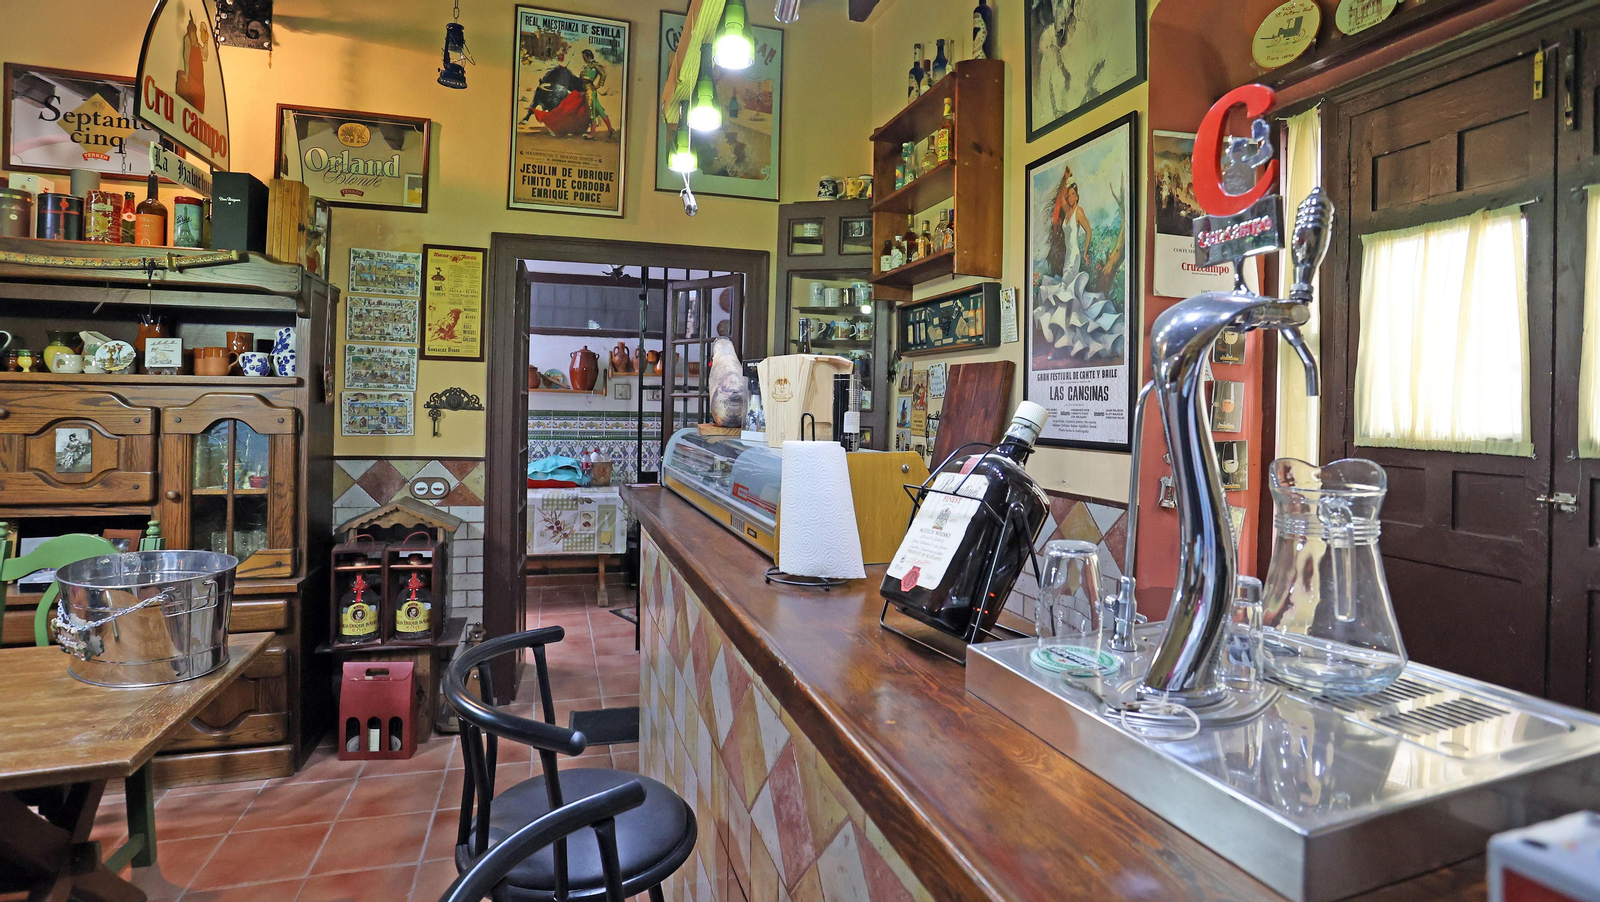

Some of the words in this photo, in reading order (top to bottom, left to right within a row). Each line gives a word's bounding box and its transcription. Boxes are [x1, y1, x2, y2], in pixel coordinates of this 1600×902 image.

[525, 16, 538, 26] REAL
[542, 18, 578, 32] MAESTRANZA
[582, 24, 588, 34] DE
[591, 26, 620, 38] SEVILLA
[143, 75, 174, 124] Cru
[182, 107, 228, 158] campo
[70, 127, 126, 154] cinq
[84, 153, 108, 162] TERKEN
[154, 146, 168, 172] La
[304, 147, 400, 178] Orland
[323, 164, 384, 188] Blonde
[520, 164, 557, 176] JESULIN
[562, 168, 572, 178] DE
[578, 168, 614, 182] UBRIQUE
[522, 175, 550, 188] FINITO
[556, 178, 566, 188] DE
[571, 180, 610, 192] CORDOBA
[532, 188, 568, 200] ENRIQUE
[574, 191, 602, 203] PONCE
[1038, 373, 1049, 381] GRAN
[1050, 372, 1072, 380] FESTIVAL
[1073, 371, 1079, 380] DE
[1080, 370, 1095, 379] CANTE
[1097, 370, 1100, 378] Y
[1102, 369, 1118, 378] BAILE
[1050, 386, 1064, 401] LAS
[1068, 385, 1109, 401] CANSINAS
[942, 496, 962, 504] FINEST
[935, 530, 952, 538] WHISKY
